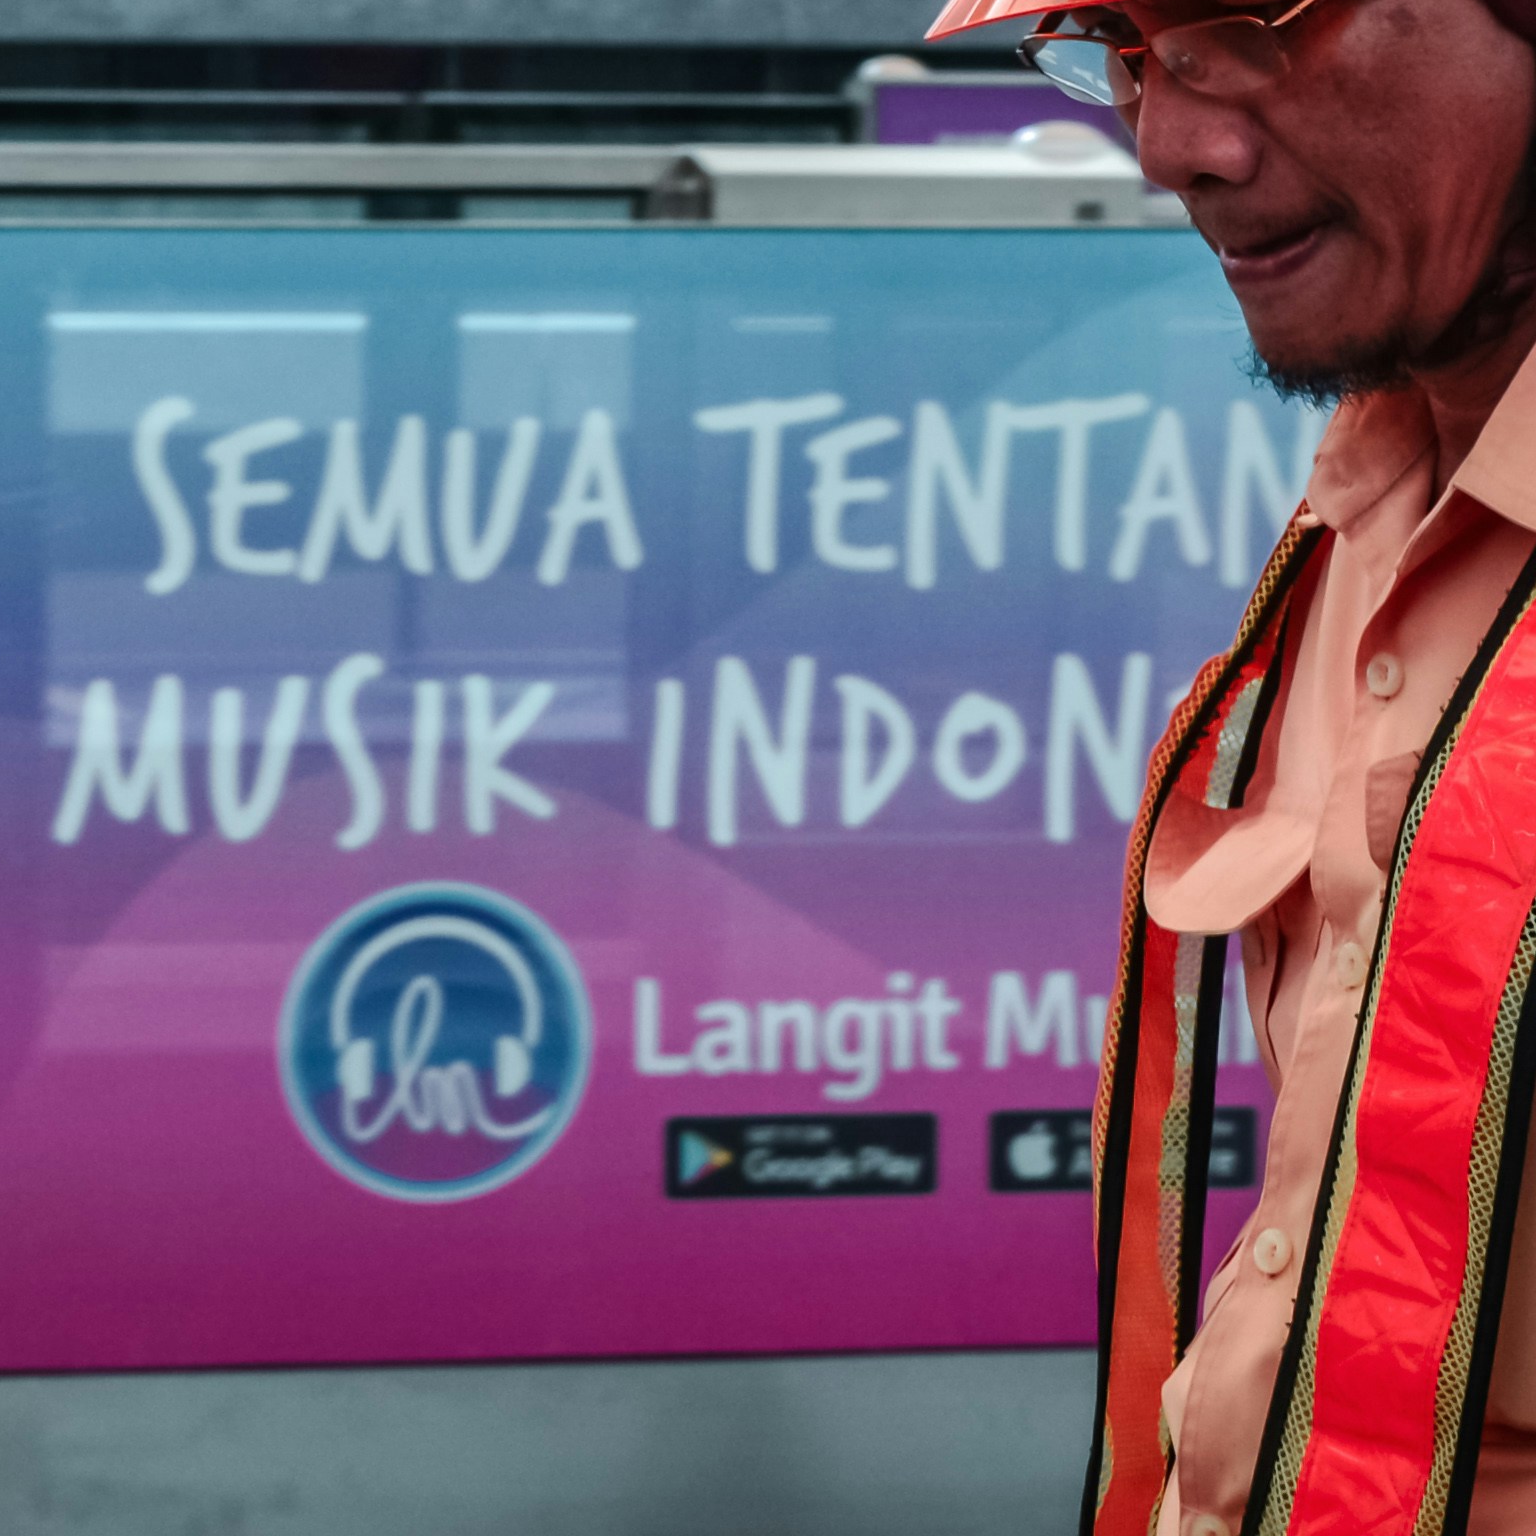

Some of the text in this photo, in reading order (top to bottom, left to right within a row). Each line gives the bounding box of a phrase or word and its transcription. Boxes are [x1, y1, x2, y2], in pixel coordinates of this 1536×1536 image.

[132, 395, 645, 595] SEMUA
[52, 651, 1179, 852] MUSIK INDON
[633, 969, 962, 1102] Langit
[742, 1145, 922, 1189] Google Play
